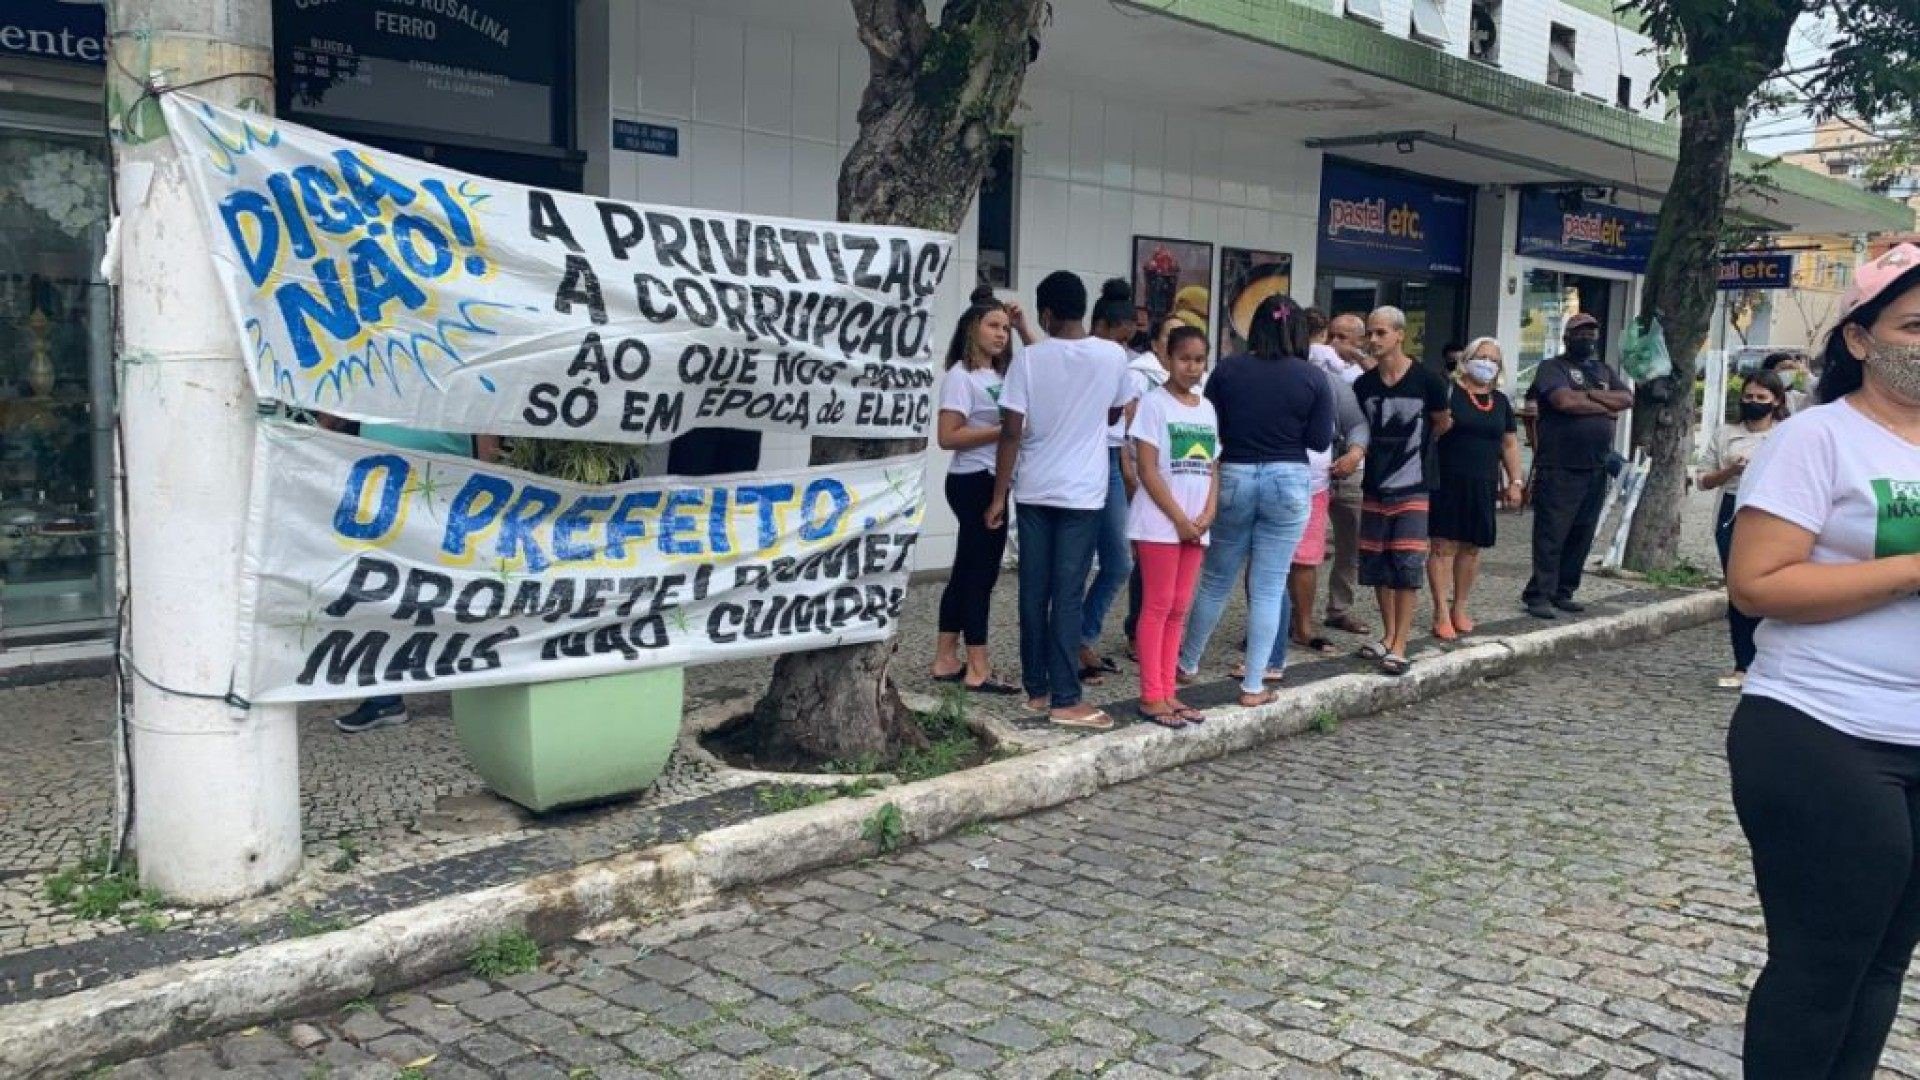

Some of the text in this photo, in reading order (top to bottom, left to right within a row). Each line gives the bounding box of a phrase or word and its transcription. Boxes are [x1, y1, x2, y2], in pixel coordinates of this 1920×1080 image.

[375, 11, 436, 40] FERRO
[219, 149, 416, 287] DIGA
[529, 190, 951, 306] A PRIVATIZAÇ
[1328, 197, 1424, 240] pastel etc.
[1561, 213, 1627, 248] pastel etc.
[555, 254, 608, 325] A
[1741, 260, 1785, 279] etc.
[678, 343, 761, 385] QUE
[523, 377, 932, 440] SÓ EM ÉPOCA de ELEIÇ
[333, 453, 410, 541] O
[296, 625, 519, 687] MAIS
